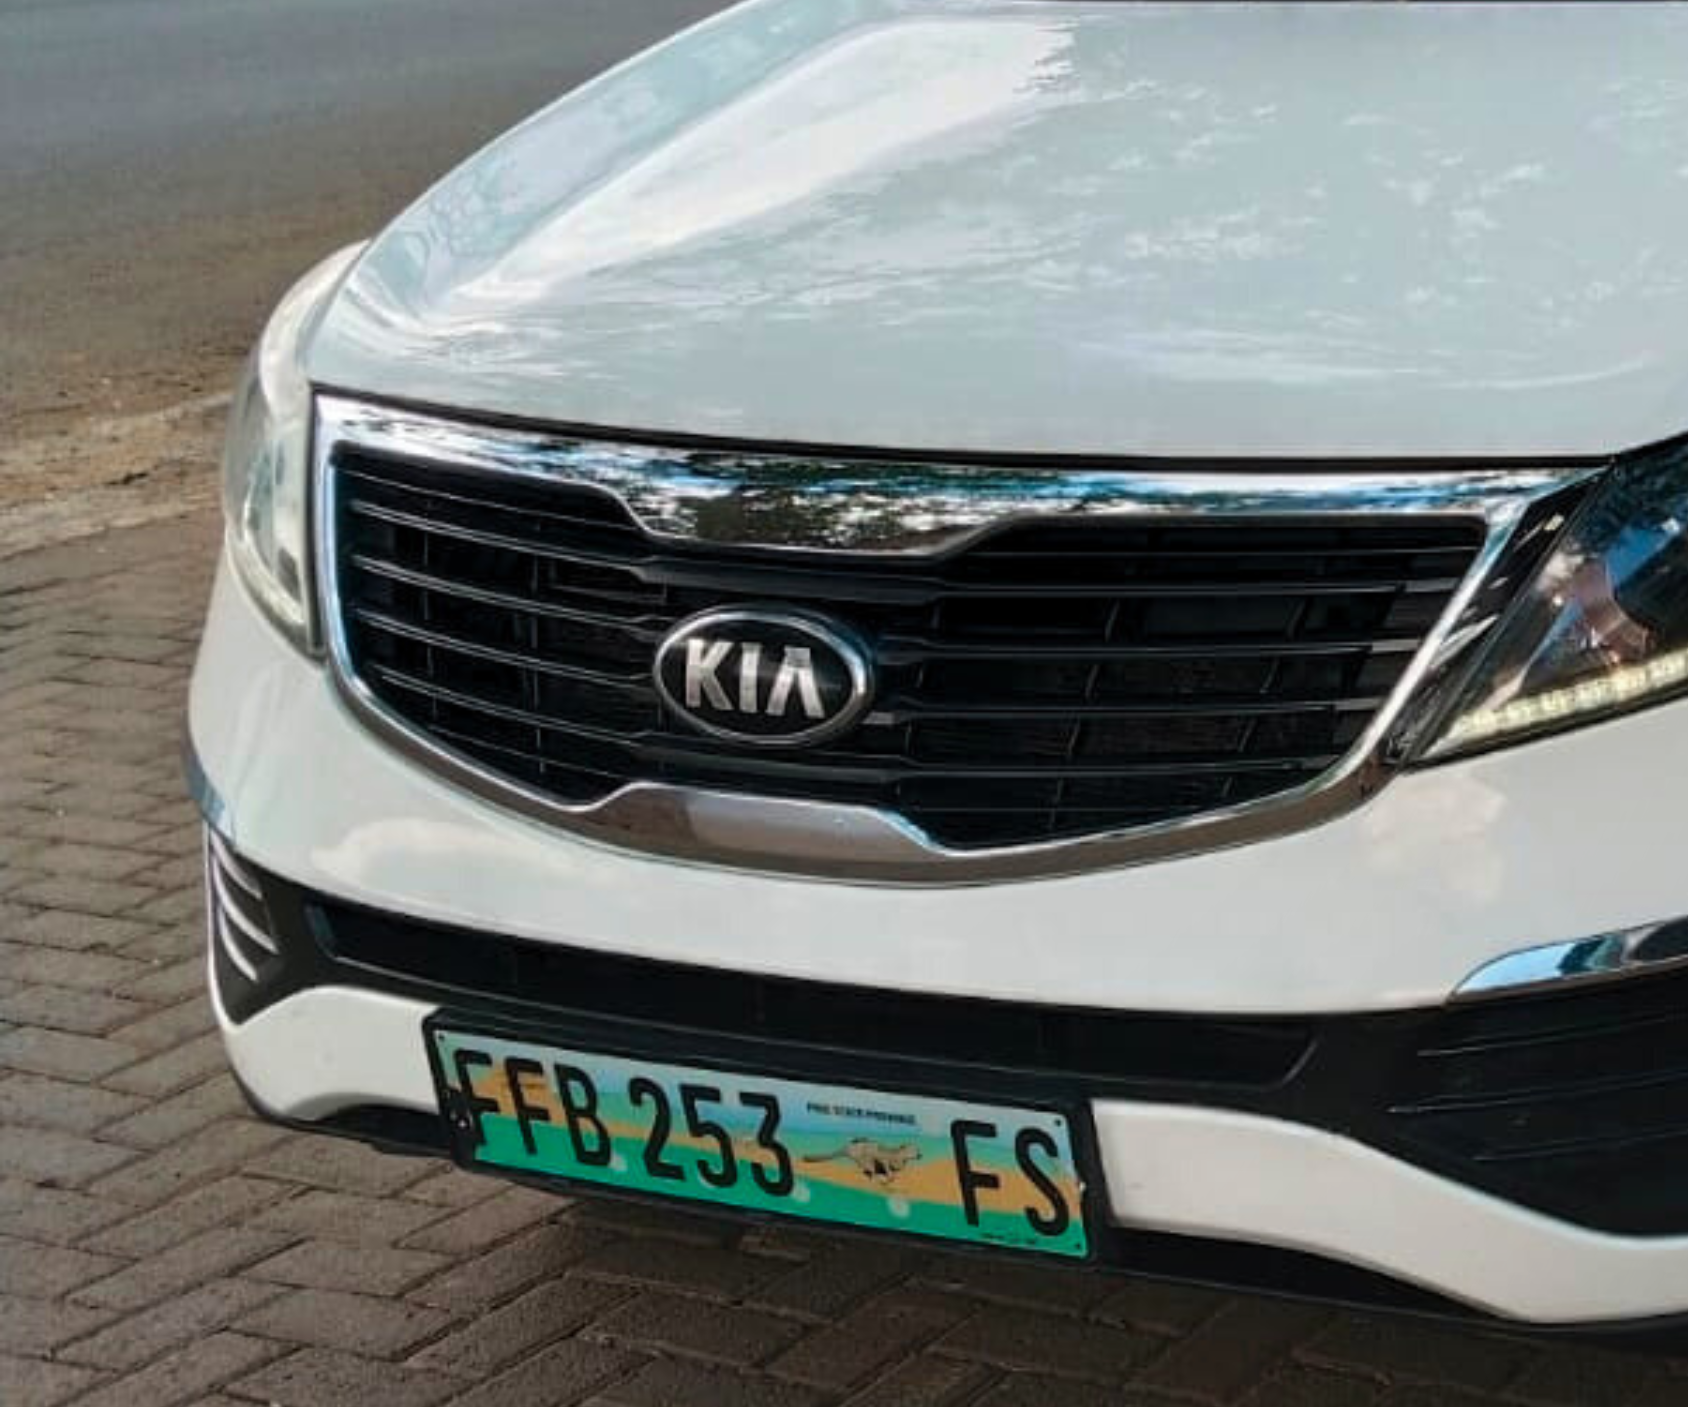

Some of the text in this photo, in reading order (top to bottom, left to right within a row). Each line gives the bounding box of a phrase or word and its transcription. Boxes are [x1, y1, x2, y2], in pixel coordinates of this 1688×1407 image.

[686, 638, 825, 719] KIA
[453, 1047, 1071, 1237] FFB 253 FS
